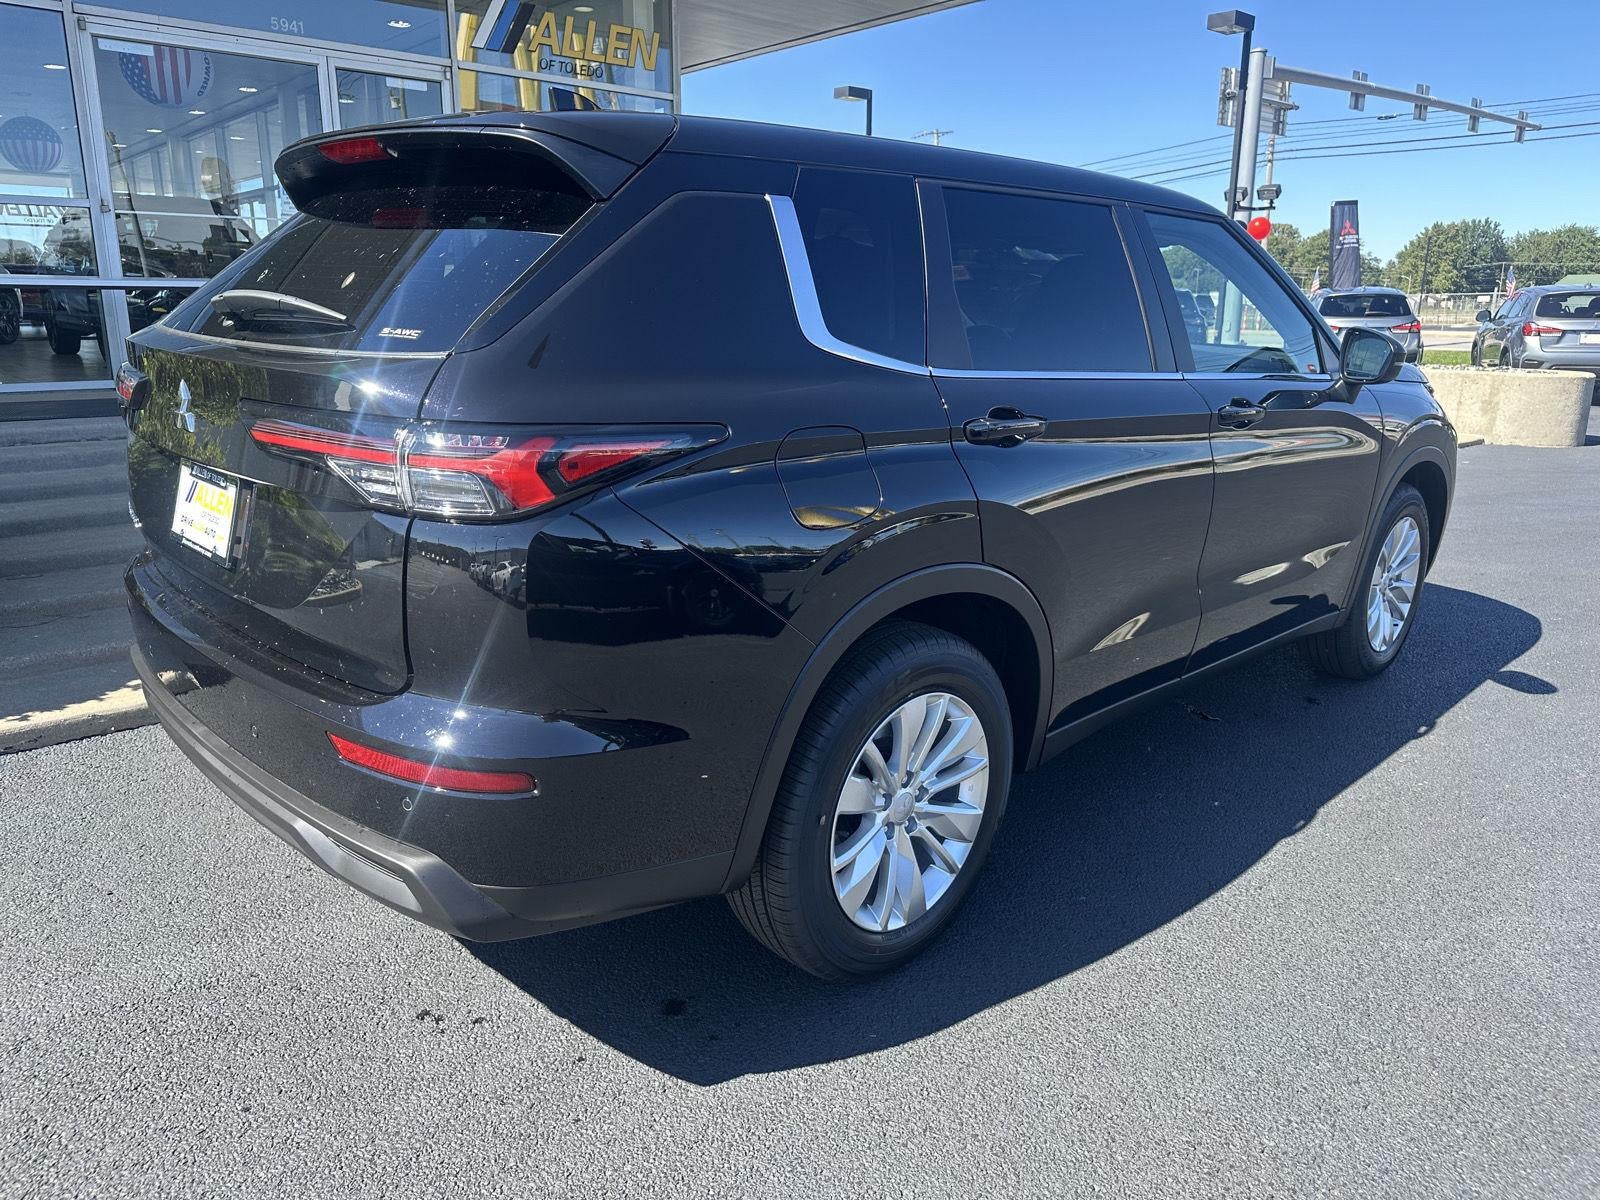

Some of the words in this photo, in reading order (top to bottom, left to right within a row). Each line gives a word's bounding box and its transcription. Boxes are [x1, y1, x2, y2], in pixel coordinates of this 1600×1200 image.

[271, 16, 304, 34] 5941
[528, 11, 661, 71] ALLEN
[197, 57, 211, 97] OWNED
[539, 58, 556, 71] OF
[559, 61, 604, 79] TOLEDO
[381, 327, 421, 337] S-AWC
[194, 485, 235, 518] ALLEN
